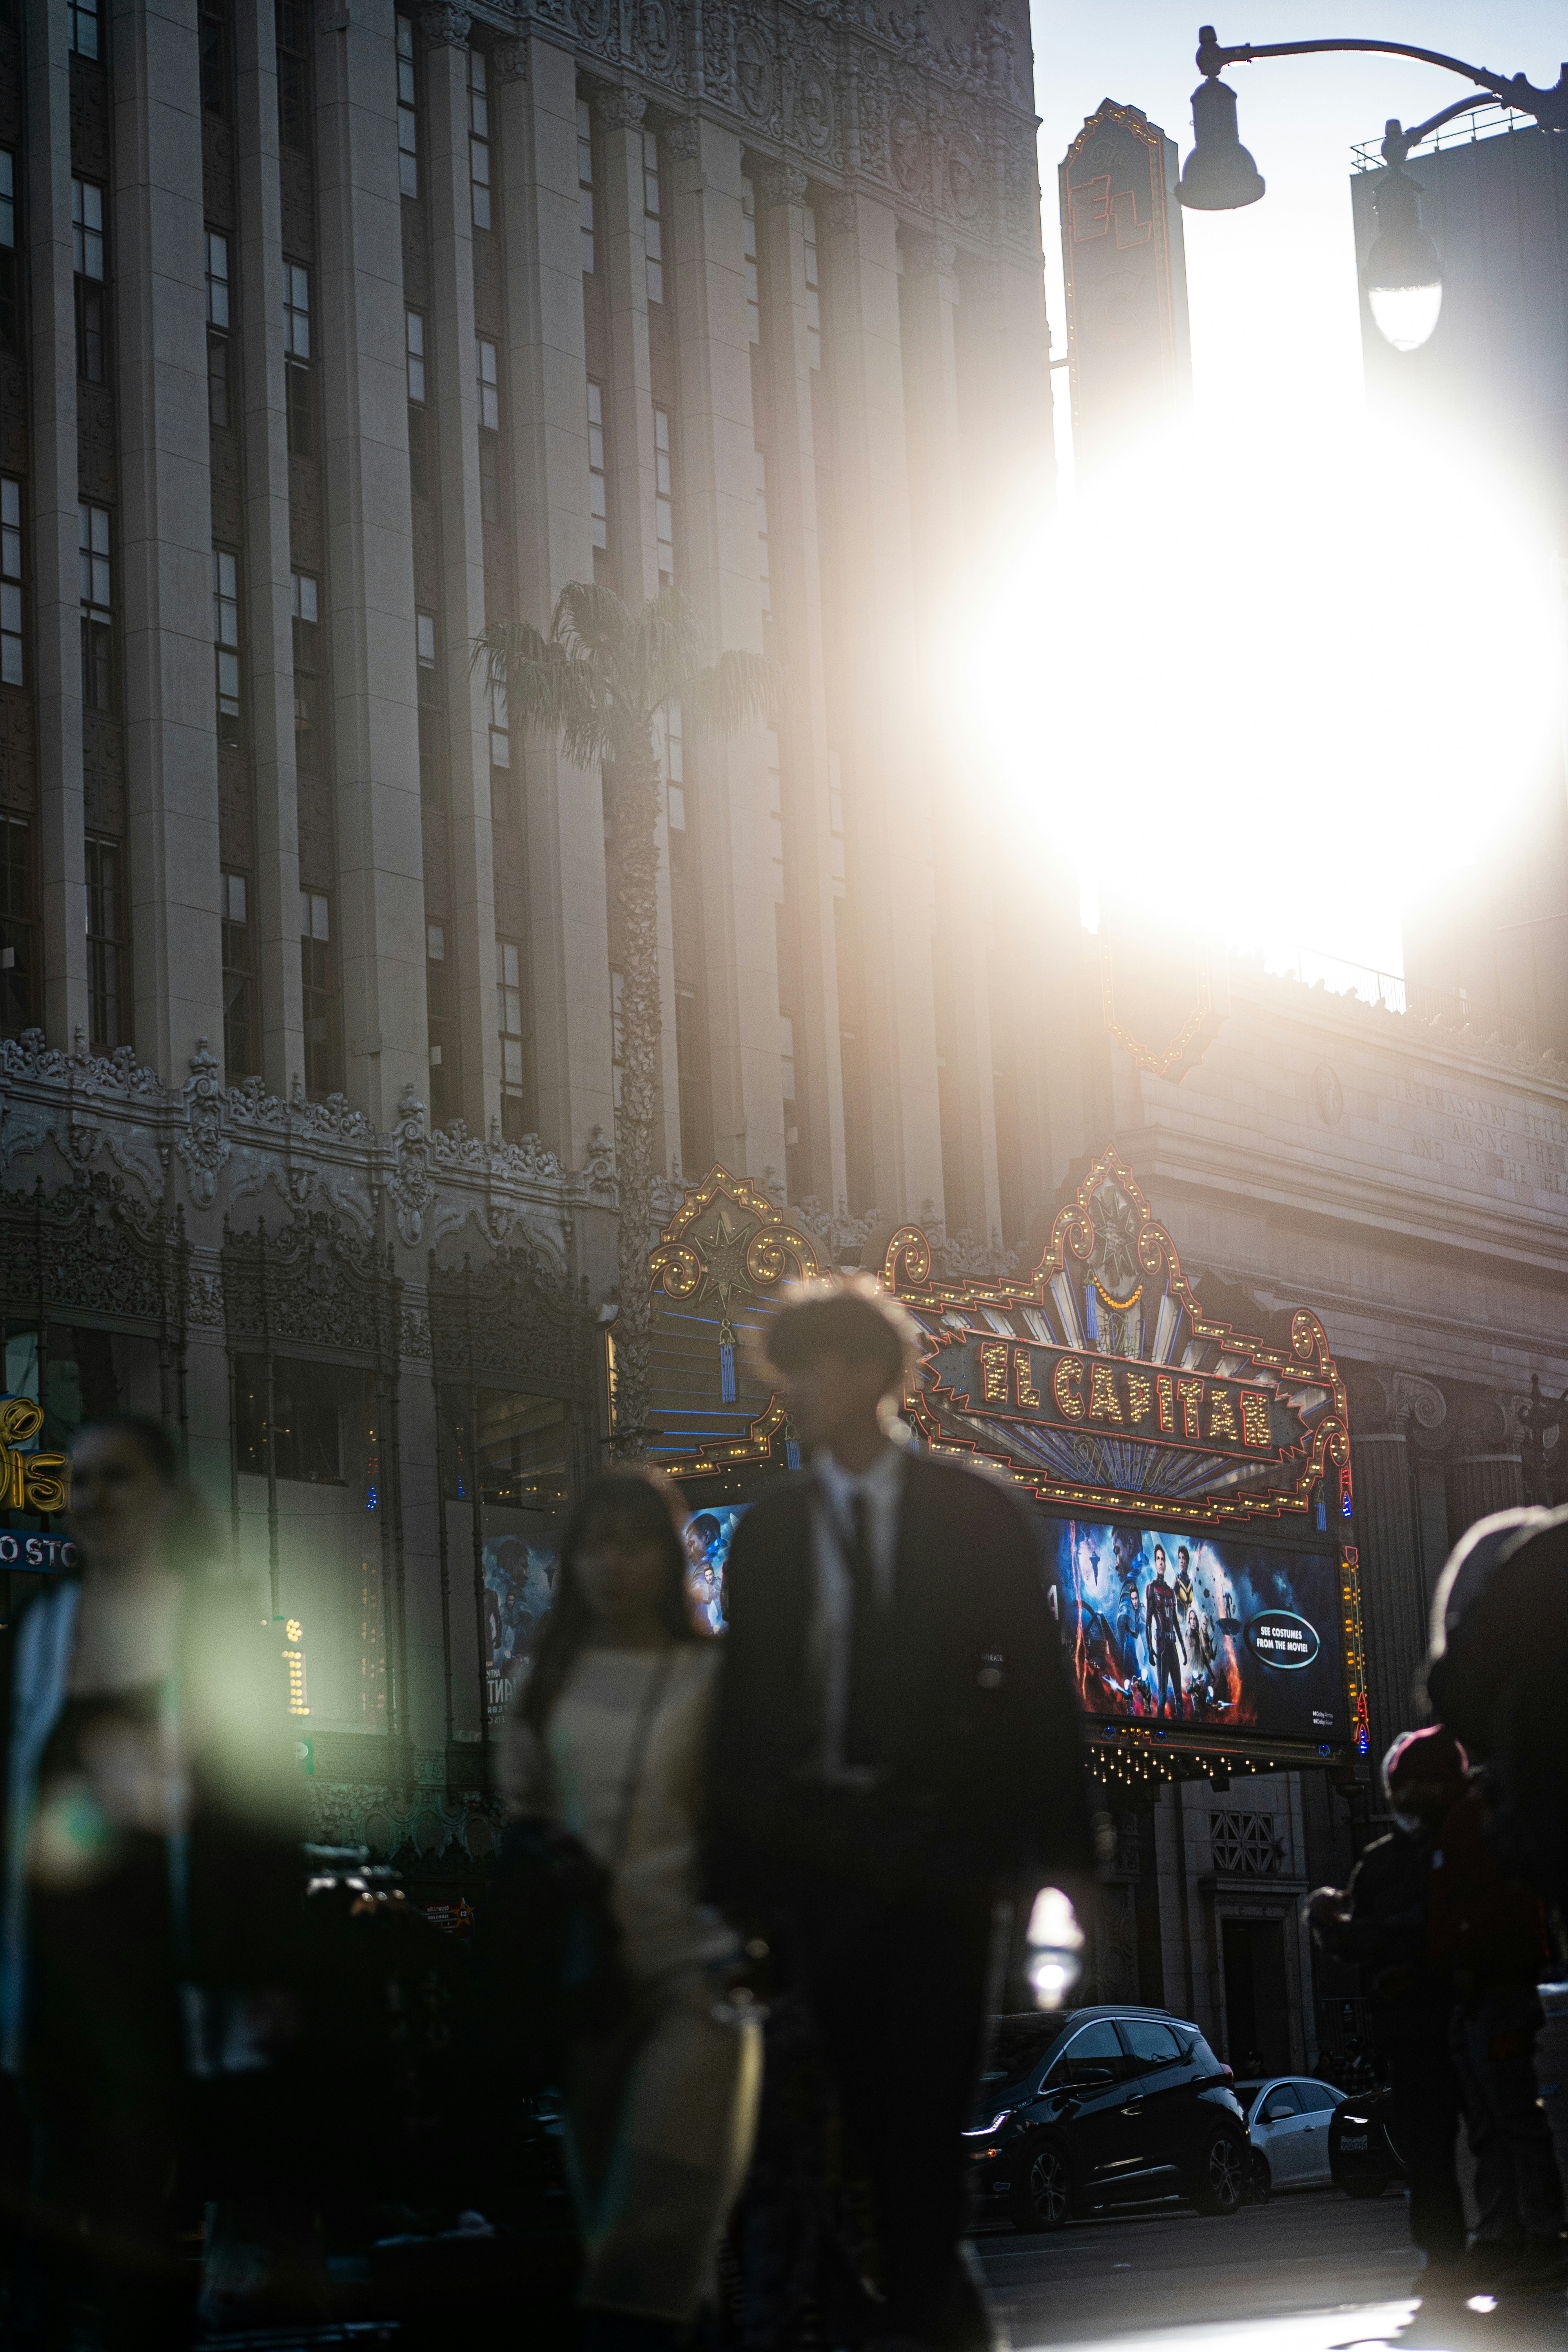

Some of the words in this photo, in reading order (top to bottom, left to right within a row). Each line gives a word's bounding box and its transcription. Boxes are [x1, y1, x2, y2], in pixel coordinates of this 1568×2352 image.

[1069, 174, 1152, 250] EL
[1394, 1079, 1508, 1127] FREEMASONRY
[1411, 1138, 1444, 1161] AND
[1463, 1150, 1481, 1171] IN
[1497, 1159, 1527, 1183] THE
[1451, 1122, 1509, 1152] AMONG
[1524, 1141, 1554, 1165] THE
[980, 1342, 1040, 1410] EL
[1054, 1355, 1272, 1450] CAPITAN
[1256, 1638, 1274, 1649] FROM
[1275, 1640, 1286, 1650] THE
[1287, 1641, 1308, 1653] MOVIE!
[1261, 1626, 1270, 1636] SEE
[1272, 1627, 1303, 1640] COSTUMES
